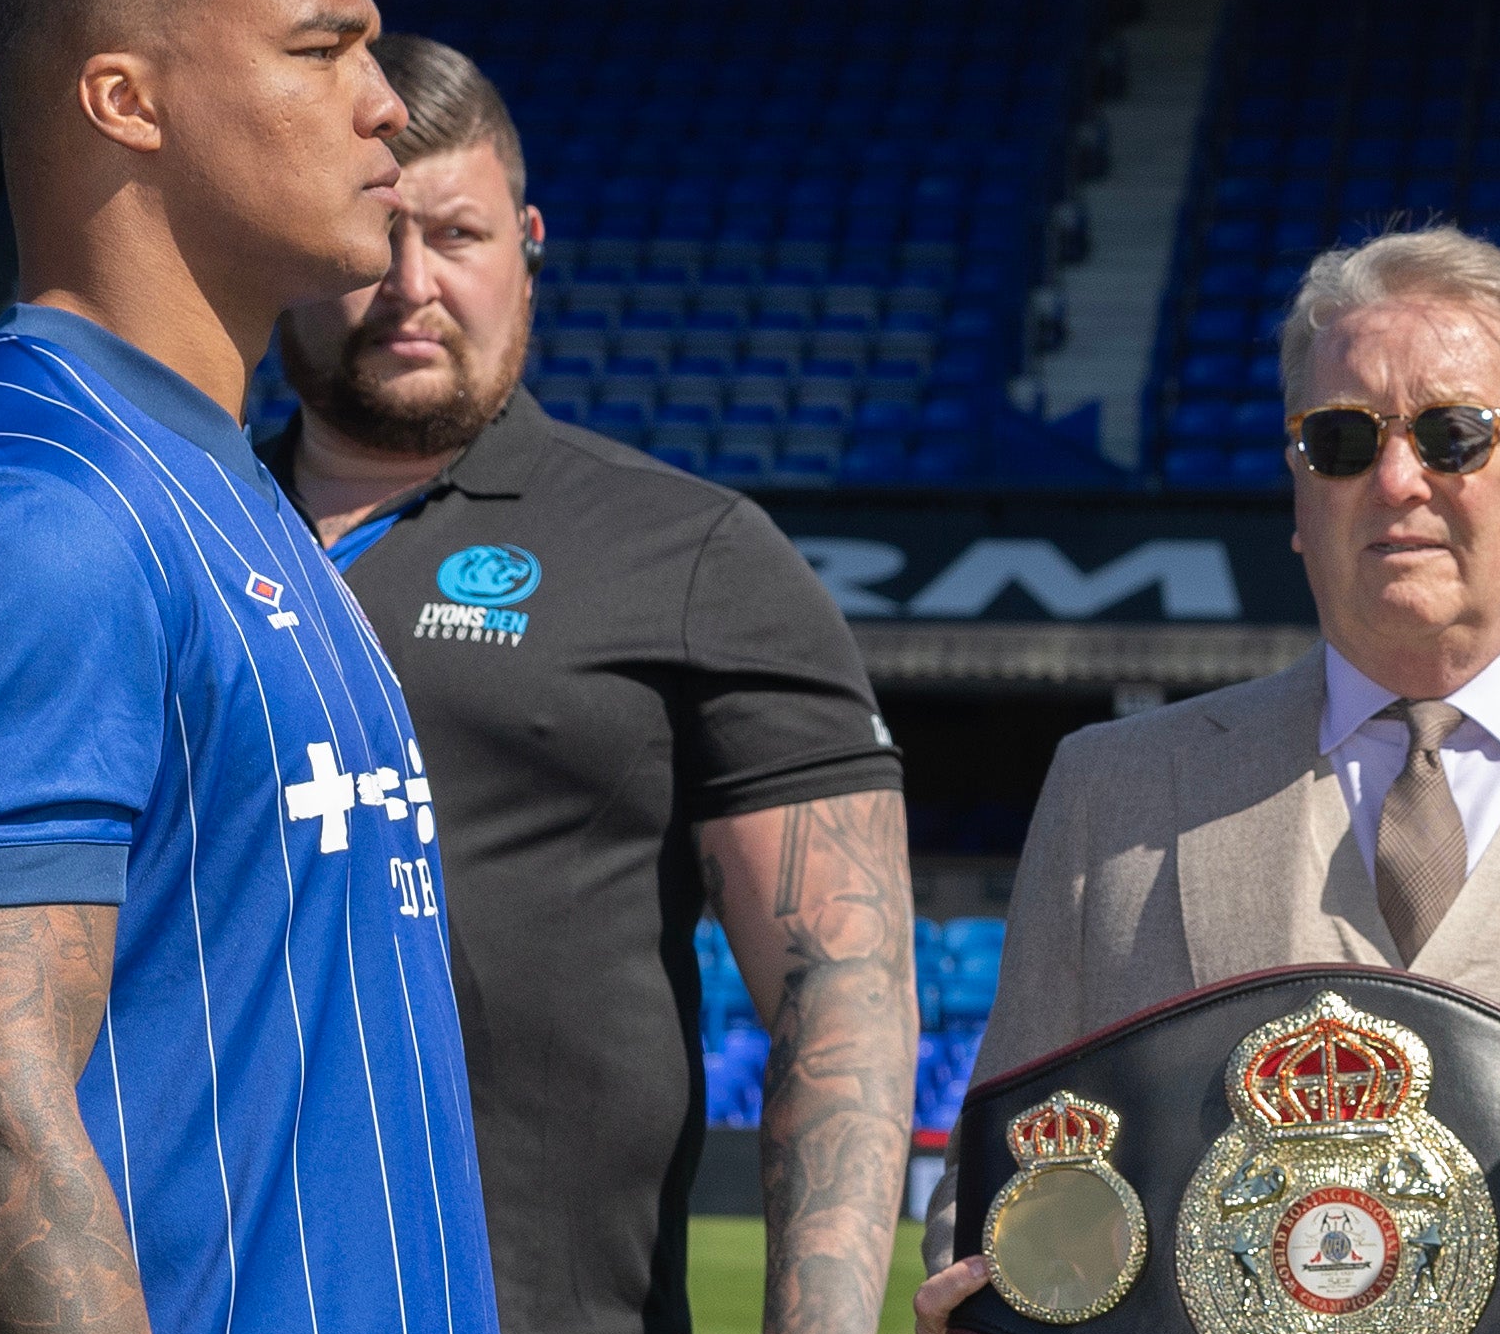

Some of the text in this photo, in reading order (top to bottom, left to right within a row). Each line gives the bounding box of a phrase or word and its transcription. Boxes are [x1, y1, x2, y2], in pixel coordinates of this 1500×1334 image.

[419, 602, 530, 635] LYONSDEN
[413, 624, 523, 648] SECURITY
[1286, 1188, 1344, 1226] BOXING
[1345, 1189, 1399, 1292] ASSOCIATION
